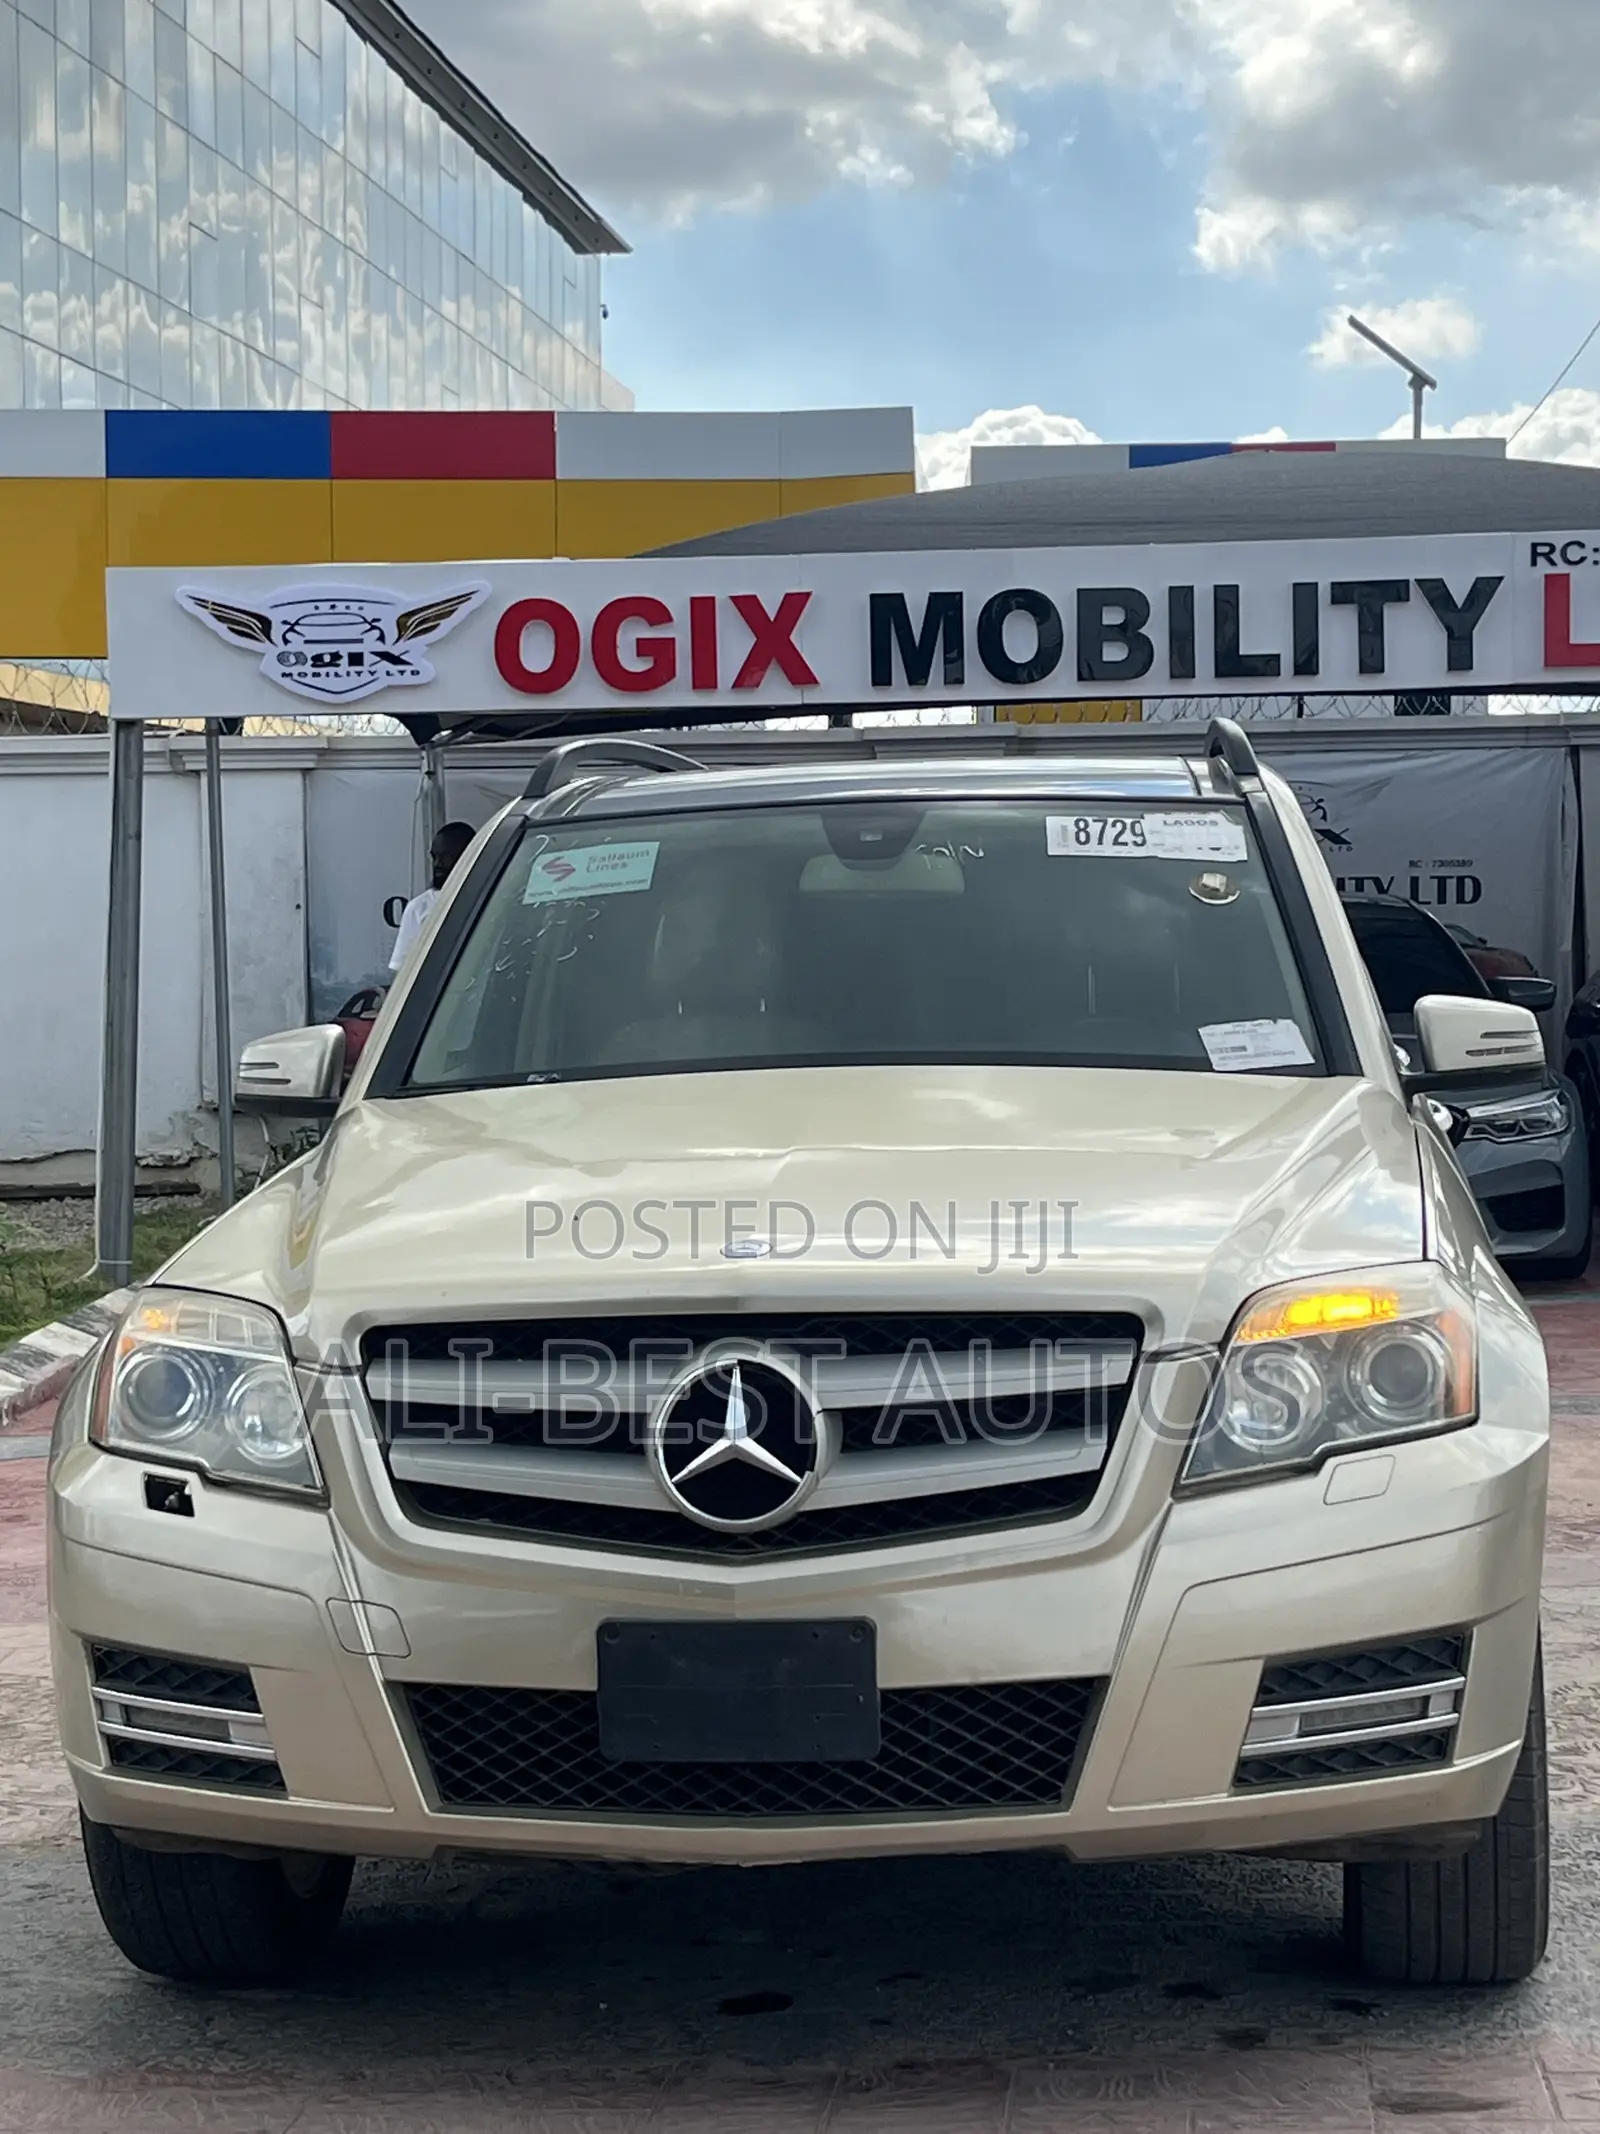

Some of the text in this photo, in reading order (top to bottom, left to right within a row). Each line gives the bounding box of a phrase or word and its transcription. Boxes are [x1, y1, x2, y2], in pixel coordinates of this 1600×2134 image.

[1530, 540, 1600, 567] RC:
[494, 591, 820, 694] OGIX
[869, 576, 1505, 688] MOBILITY
[281, 669, 420, 678] MOBILITY LTD
[1074, 818, 1147, 847] 8729
[1409, 875, 1483, 905] LTD
